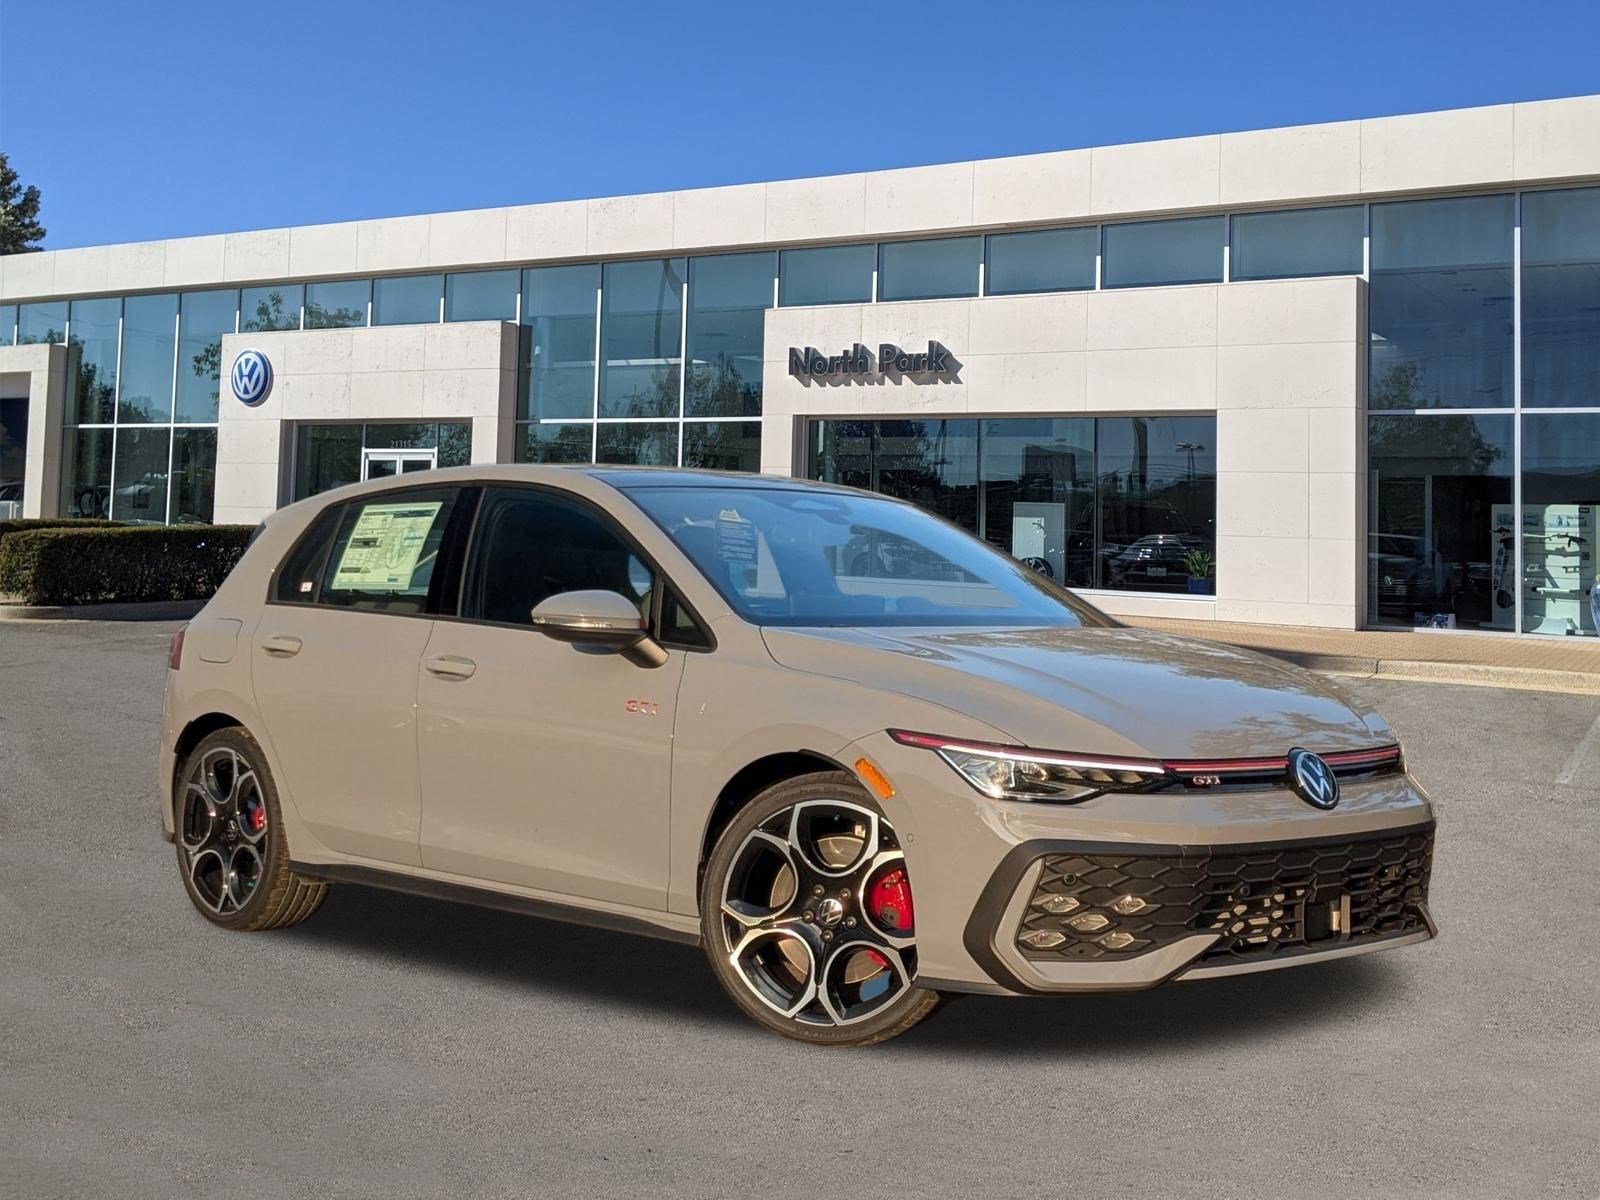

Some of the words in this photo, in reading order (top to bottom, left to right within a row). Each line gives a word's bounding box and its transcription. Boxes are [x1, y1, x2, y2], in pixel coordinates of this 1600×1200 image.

[789, 343, 870, 376] North
[879, 340, 950, 373] Park
[231, 350, 268, 403] VW
[390, 439, 412, 449] 21315
[1193, 775, 1221, 786] GTI
[1296, 751, 1338, 806] VW
